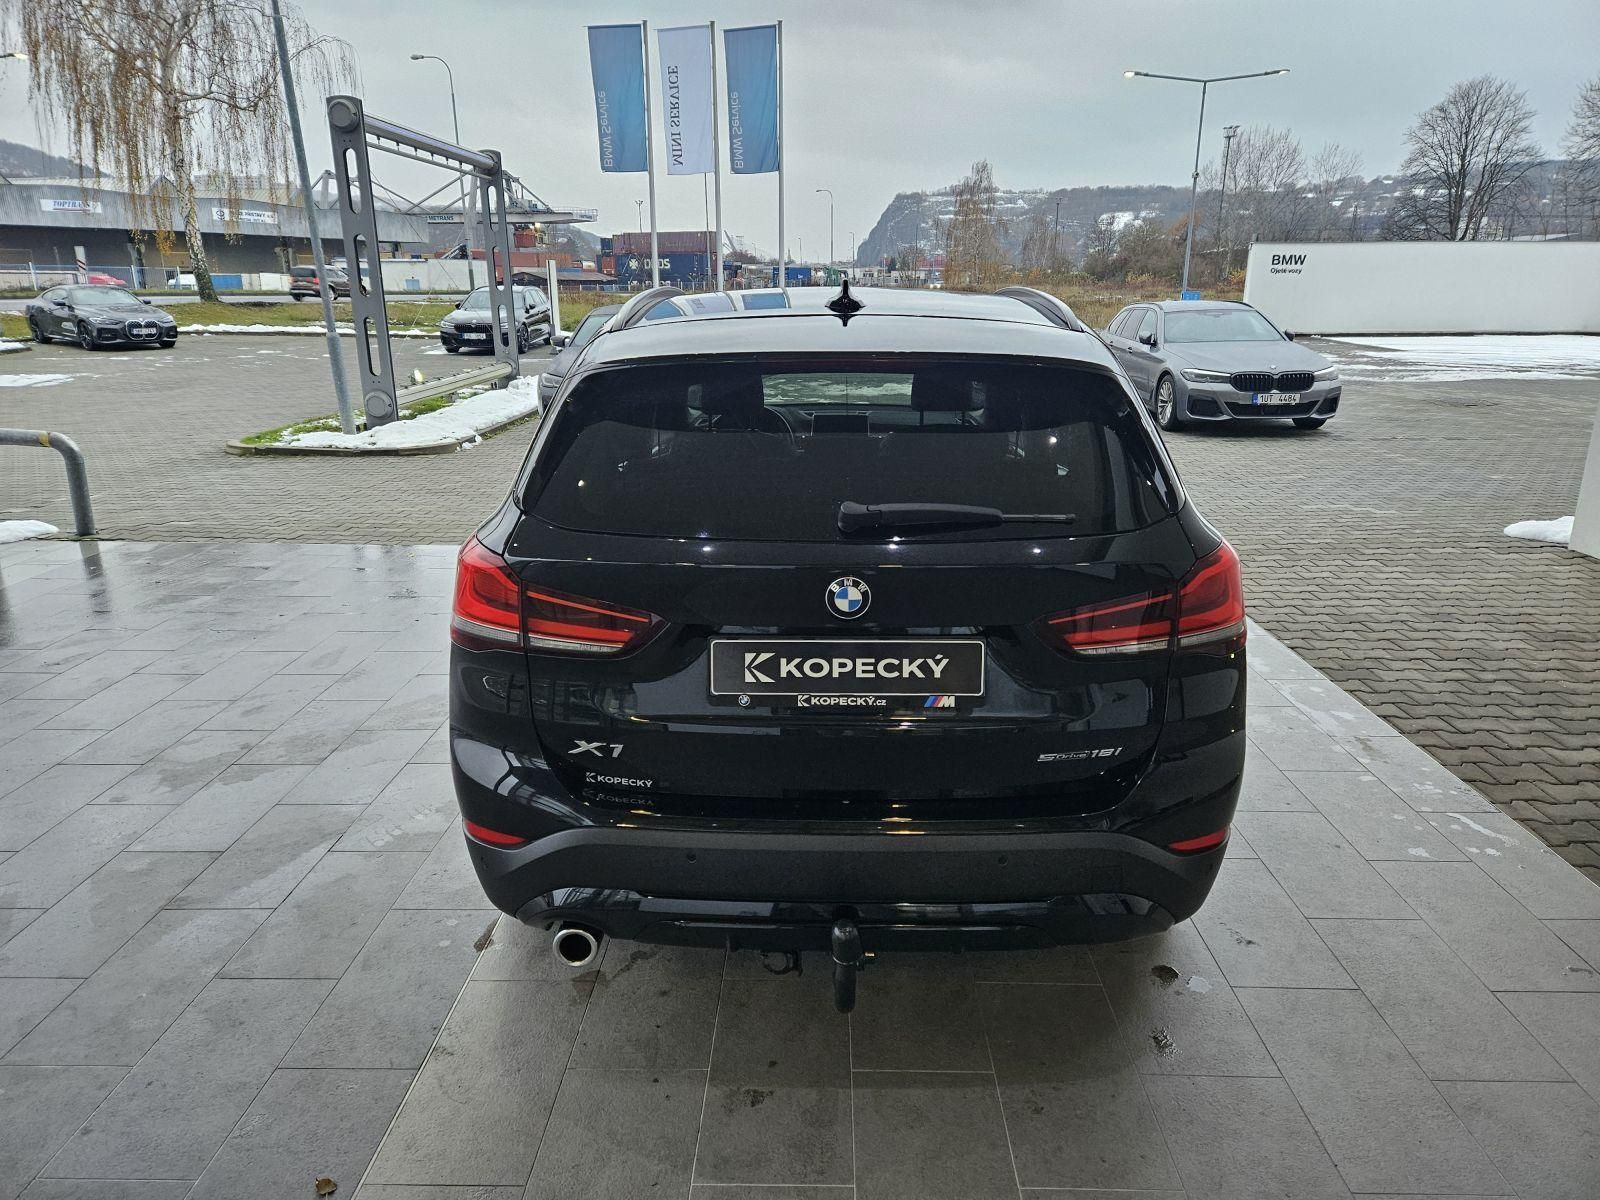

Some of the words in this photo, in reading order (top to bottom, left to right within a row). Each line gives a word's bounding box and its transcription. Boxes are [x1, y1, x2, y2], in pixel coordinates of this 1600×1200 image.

[644, 258, 671, 269] DDS
[1271, 254, 1307, 265] BMW
[1259, 394, 1274, 404] 1UT
[1279, 394, 1297, 403] 4484
[780, 654, 950, 678] KOPECKÝ
[811, 696, 887, 707] KOPECKÝ.cz
[568, 740, 624, 757] X1
[597, 775, 653, 787] KOPECKÝ
